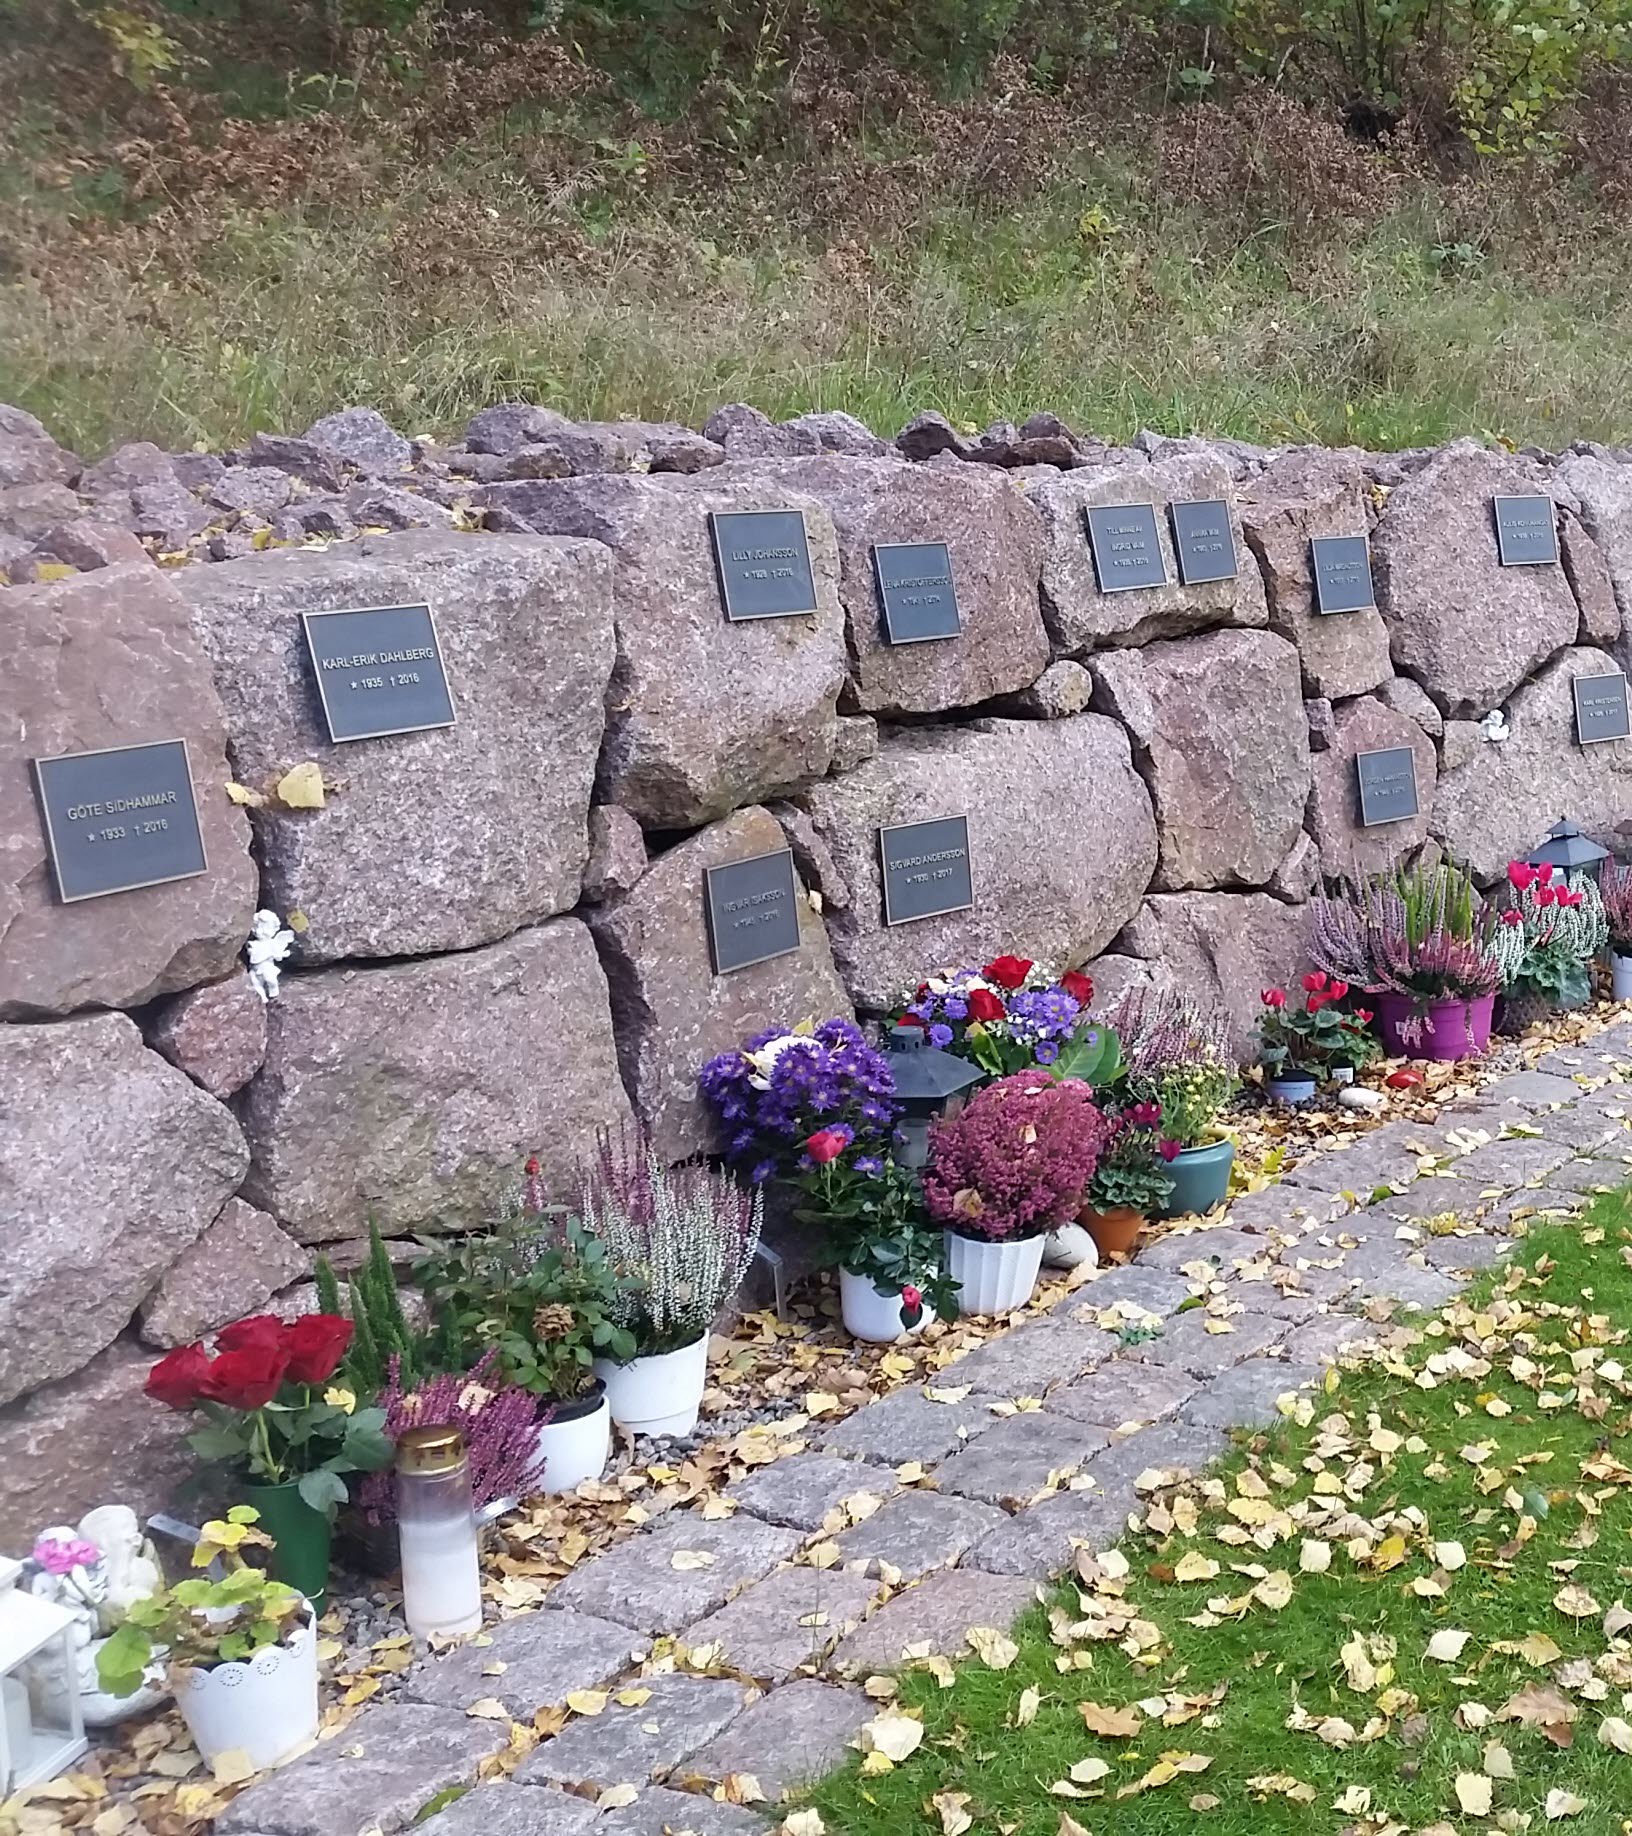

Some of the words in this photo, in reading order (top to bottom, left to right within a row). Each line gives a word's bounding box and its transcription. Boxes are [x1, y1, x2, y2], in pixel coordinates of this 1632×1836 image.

[732, 550, 752, 561] LILLY
[753, 547, 799, 559] JOHANSSON
[321, 652, 379, 670] KARL-ERIK
[380, 647, 435, 664] DAHLBERG
[361, 676, 384, 689] 1935
[398, 672, 420, 685] 2016
[67, 802, 103, 820] GÖTE
[105, 791, 178, 814] SIDHAMMAR
[100, 826, 126, 841] 1933
[144, 819, 169, 834] 2016
[890, 856, 922, 871] SIGVARD
[923, 847, 966, 864] ANDERSSON
